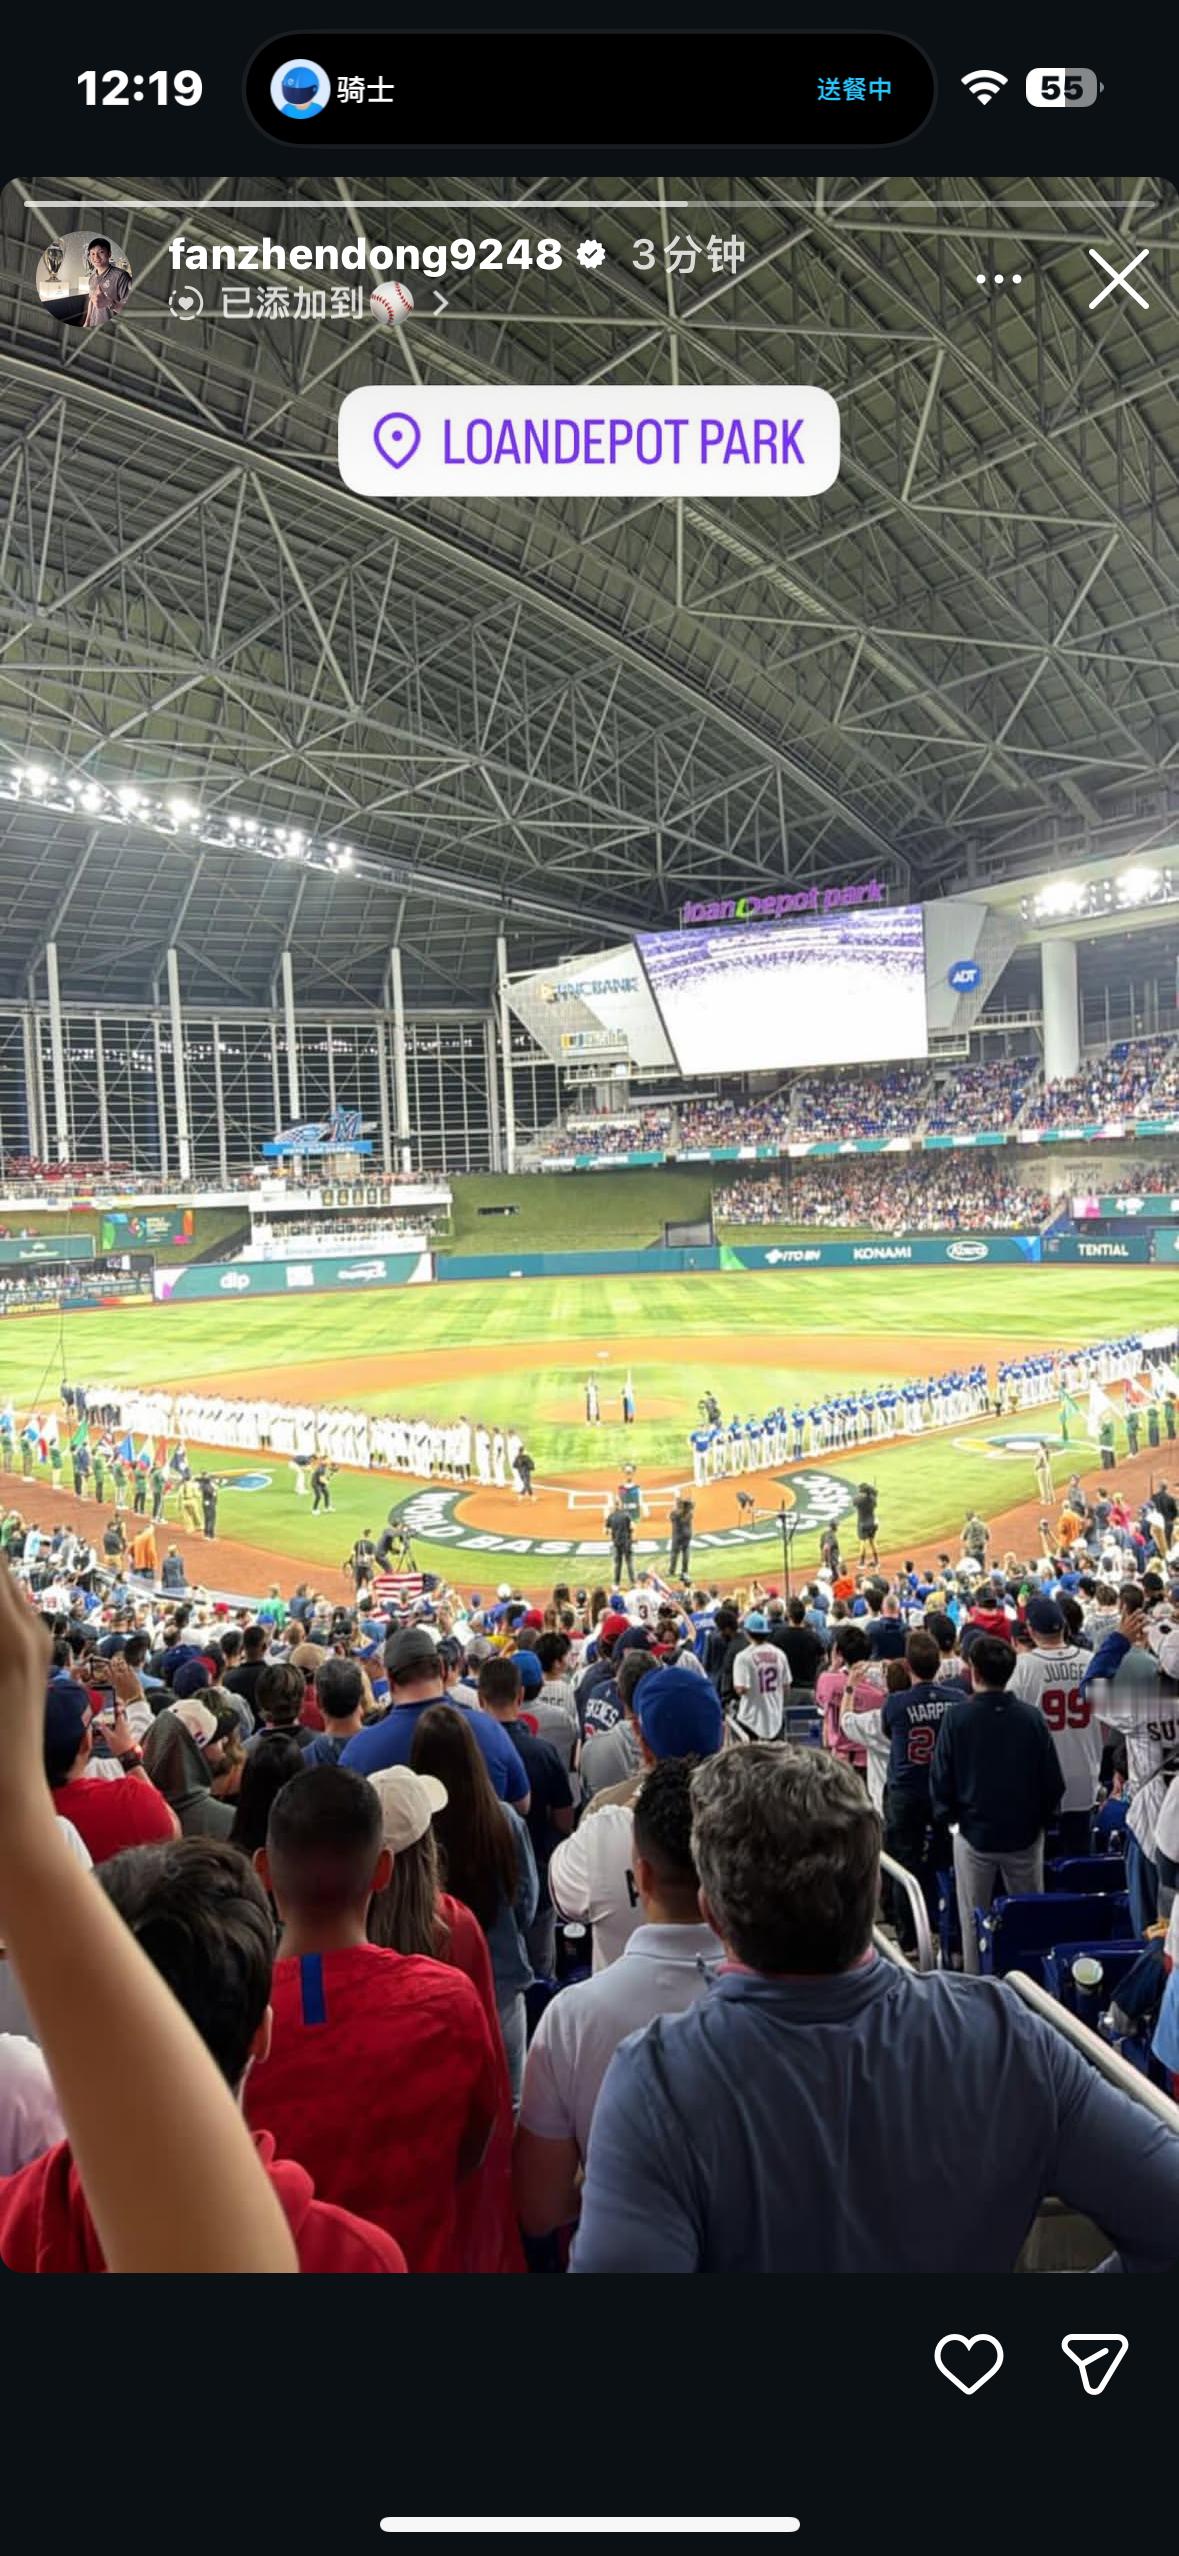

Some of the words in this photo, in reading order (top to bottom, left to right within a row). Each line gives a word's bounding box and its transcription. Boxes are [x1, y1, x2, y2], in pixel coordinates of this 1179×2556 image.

[823, 879, 885, 912] park
[952, 969, 977, 983] ADT
[853, 1246, 912, 1260] KONAMI
[1077, 1243, 1129, 1257] TENTIAL
[402, 1492, 465, 1538] WORLD
[758, 1666, 778, 1694] 12
[1041, 1687, 1092, 1732] 99
